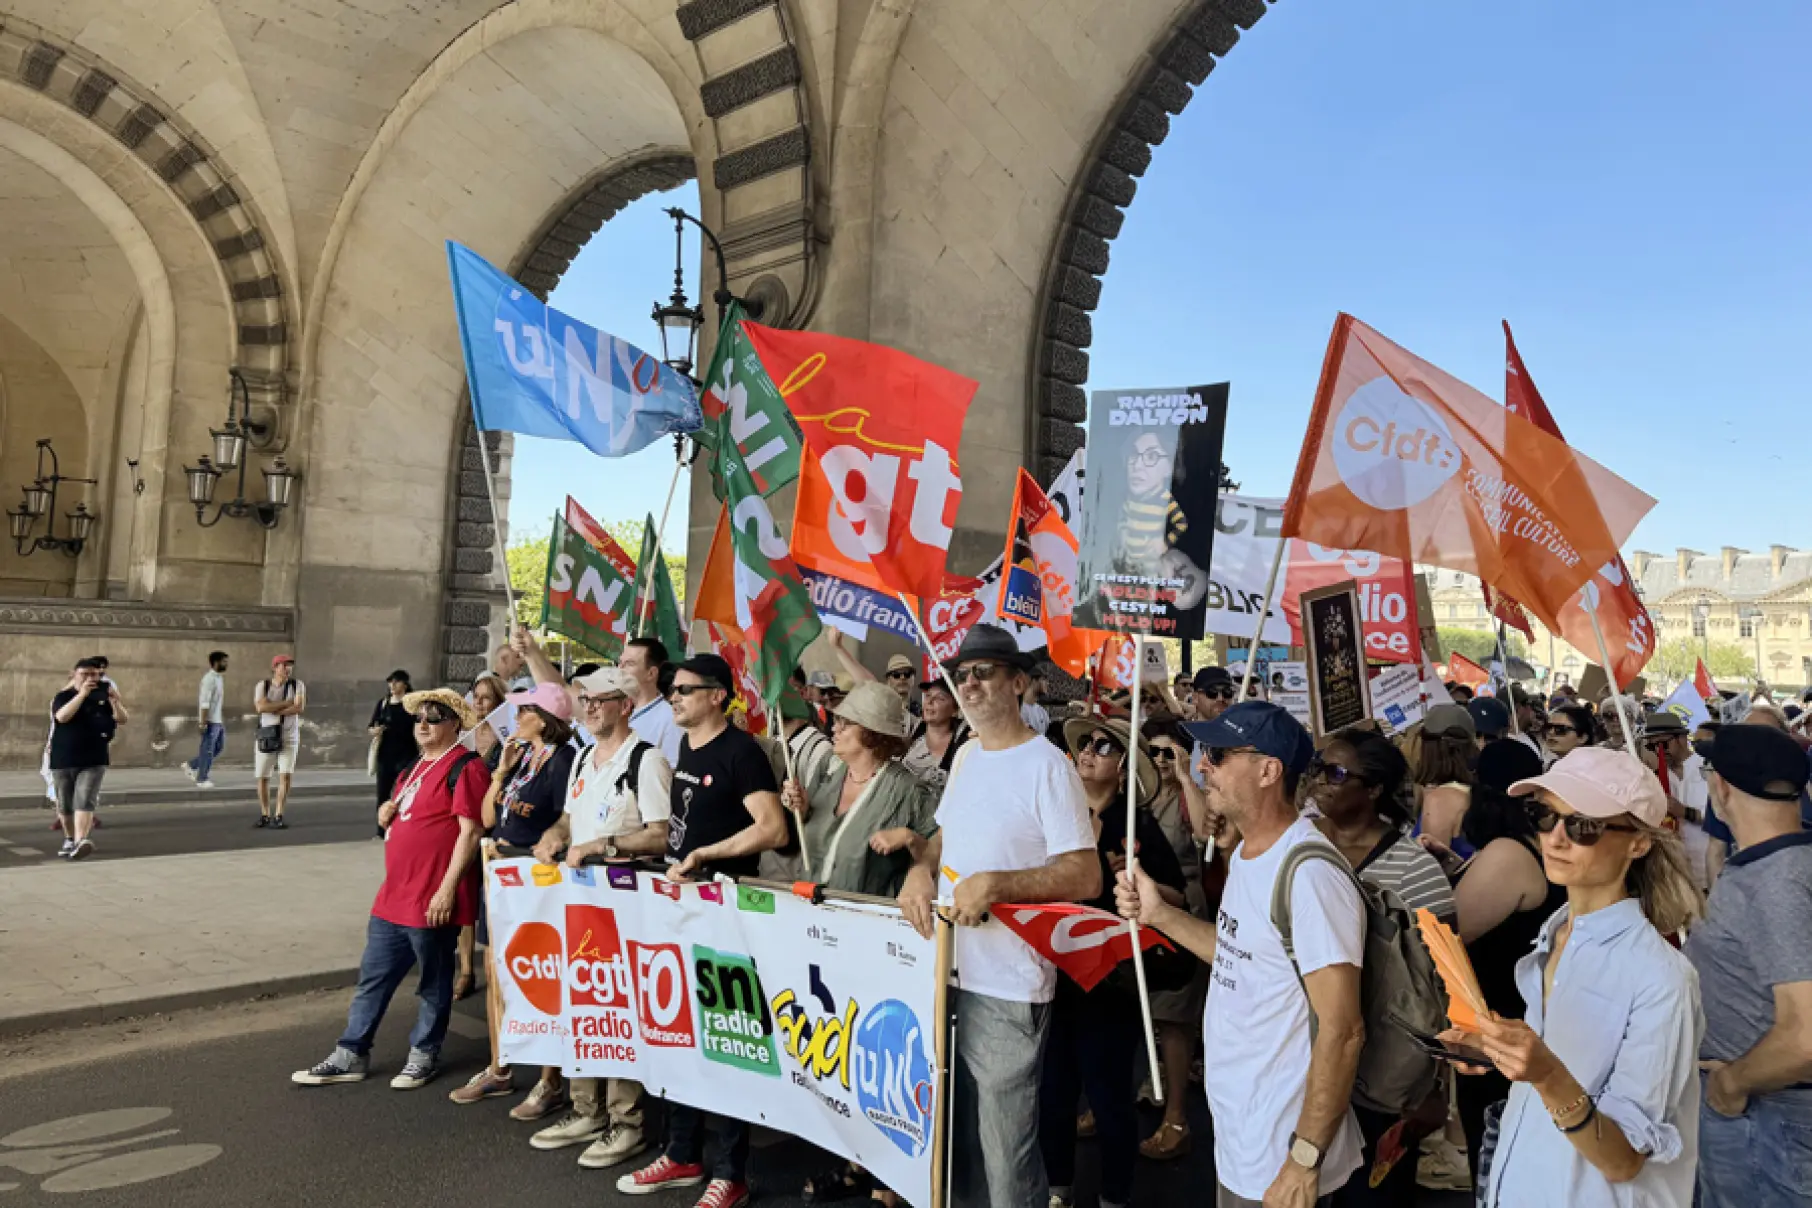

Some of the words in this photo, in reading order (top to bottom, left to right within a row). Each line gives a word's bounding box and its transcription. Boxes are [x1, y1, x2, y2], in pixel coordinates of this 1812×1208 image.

[1108, 406, 1208, 426] DALTON
[1117, 393, 1202, 409] RACHIDA
[820, 438, 963, 552] gt
[1514, 516, 1580, 568] CULTURE
[803, 574, 856, 613] adio
[857, 594, 922, 646] franc
[1103, 614, 1152, 629] HOLD
[569, 953, 627, 1003] cgt
[637, 945, 683, 1027] FO
[508, 1019, 548, 1034] Radio
[572, 1010, 633, 1040] radio
[704, 1010, 764, 1039] radio
[574, 1038, 637, 1062] france
[705, 1028, 770, 1063] france
